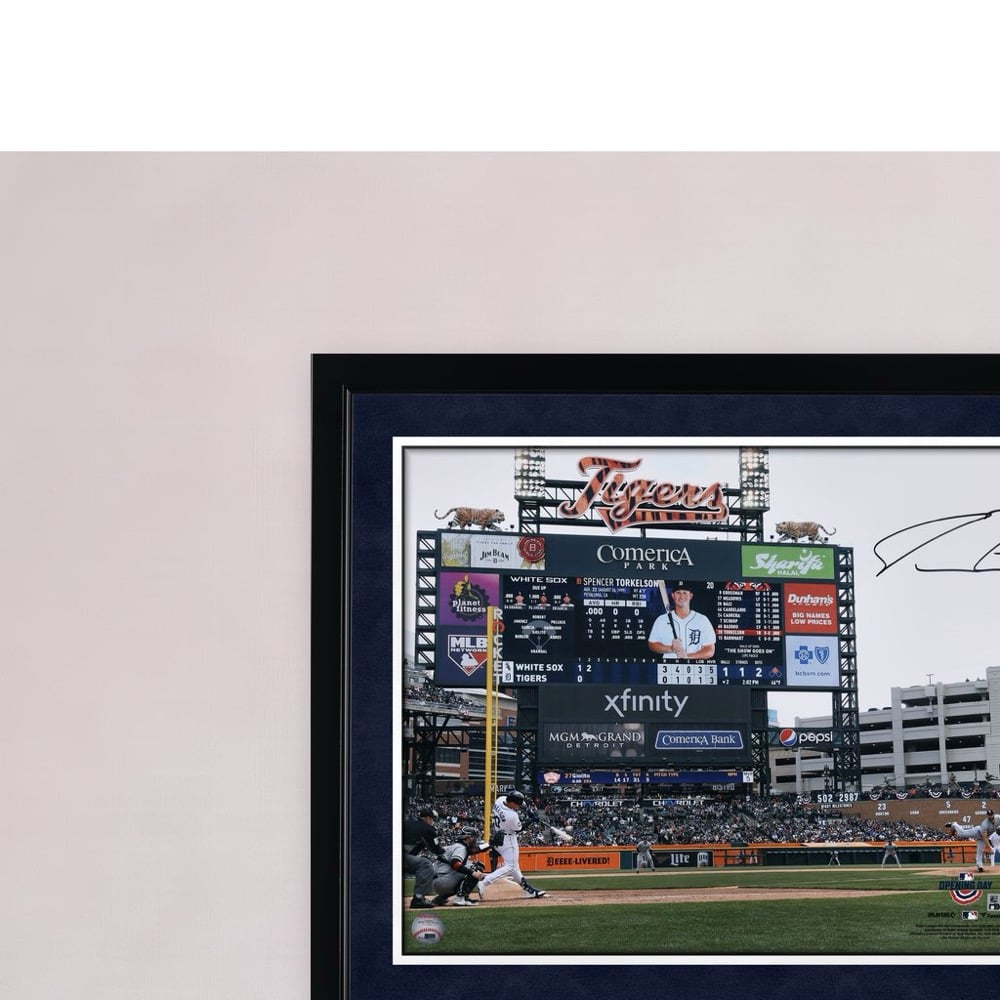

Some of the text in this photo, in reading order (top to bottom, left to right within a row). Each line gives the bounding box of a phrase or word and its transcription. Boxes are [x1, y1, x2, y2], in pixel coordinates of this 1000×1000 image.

[559, 456, 729, 534] Tigers
[624, 562, 668, 571] PARK
[583, 577, 659, 588] SPENCER TORKELSON
[706, 581, 715, 590] 20
[452, 599, 481, 607] planet
[788, 593, 833, 605] Dunham's
[456, 605, 486, 613] fitness
[585, 607, 603, 615] .000
[613, 608, 618, 616] 0
[634, 608, 640, 616] 0
[450, 636, 488, 648] MLB
[515, 663, 564, 671] WHITE SOX
[577, 664, 581, 672] 1
[586, 664, 592, 672] 2
[723, 667, 728, 677] 1
[740, 667, 745, 677] 1
[755, 668, 762, 677] 2
[516, 674, 548, 682] TIGERS
[604, 688, 689, 718] xfinity
[549, 732, 641, 742] MGM GRAND
[711, 735, 736, 744] Bank
[799, 731, 833, 744] pepsi
[817, 794, 833, 803] 502
[839, 793, 859, 802] 2987
[877, 803, 887, 811] 23
[945, 801, 951, 809] 5
[981, 801, 987, 809] 2
[670, 853, 690, 866] Lite
[939, 880, 993, 890] OPENING DAY
